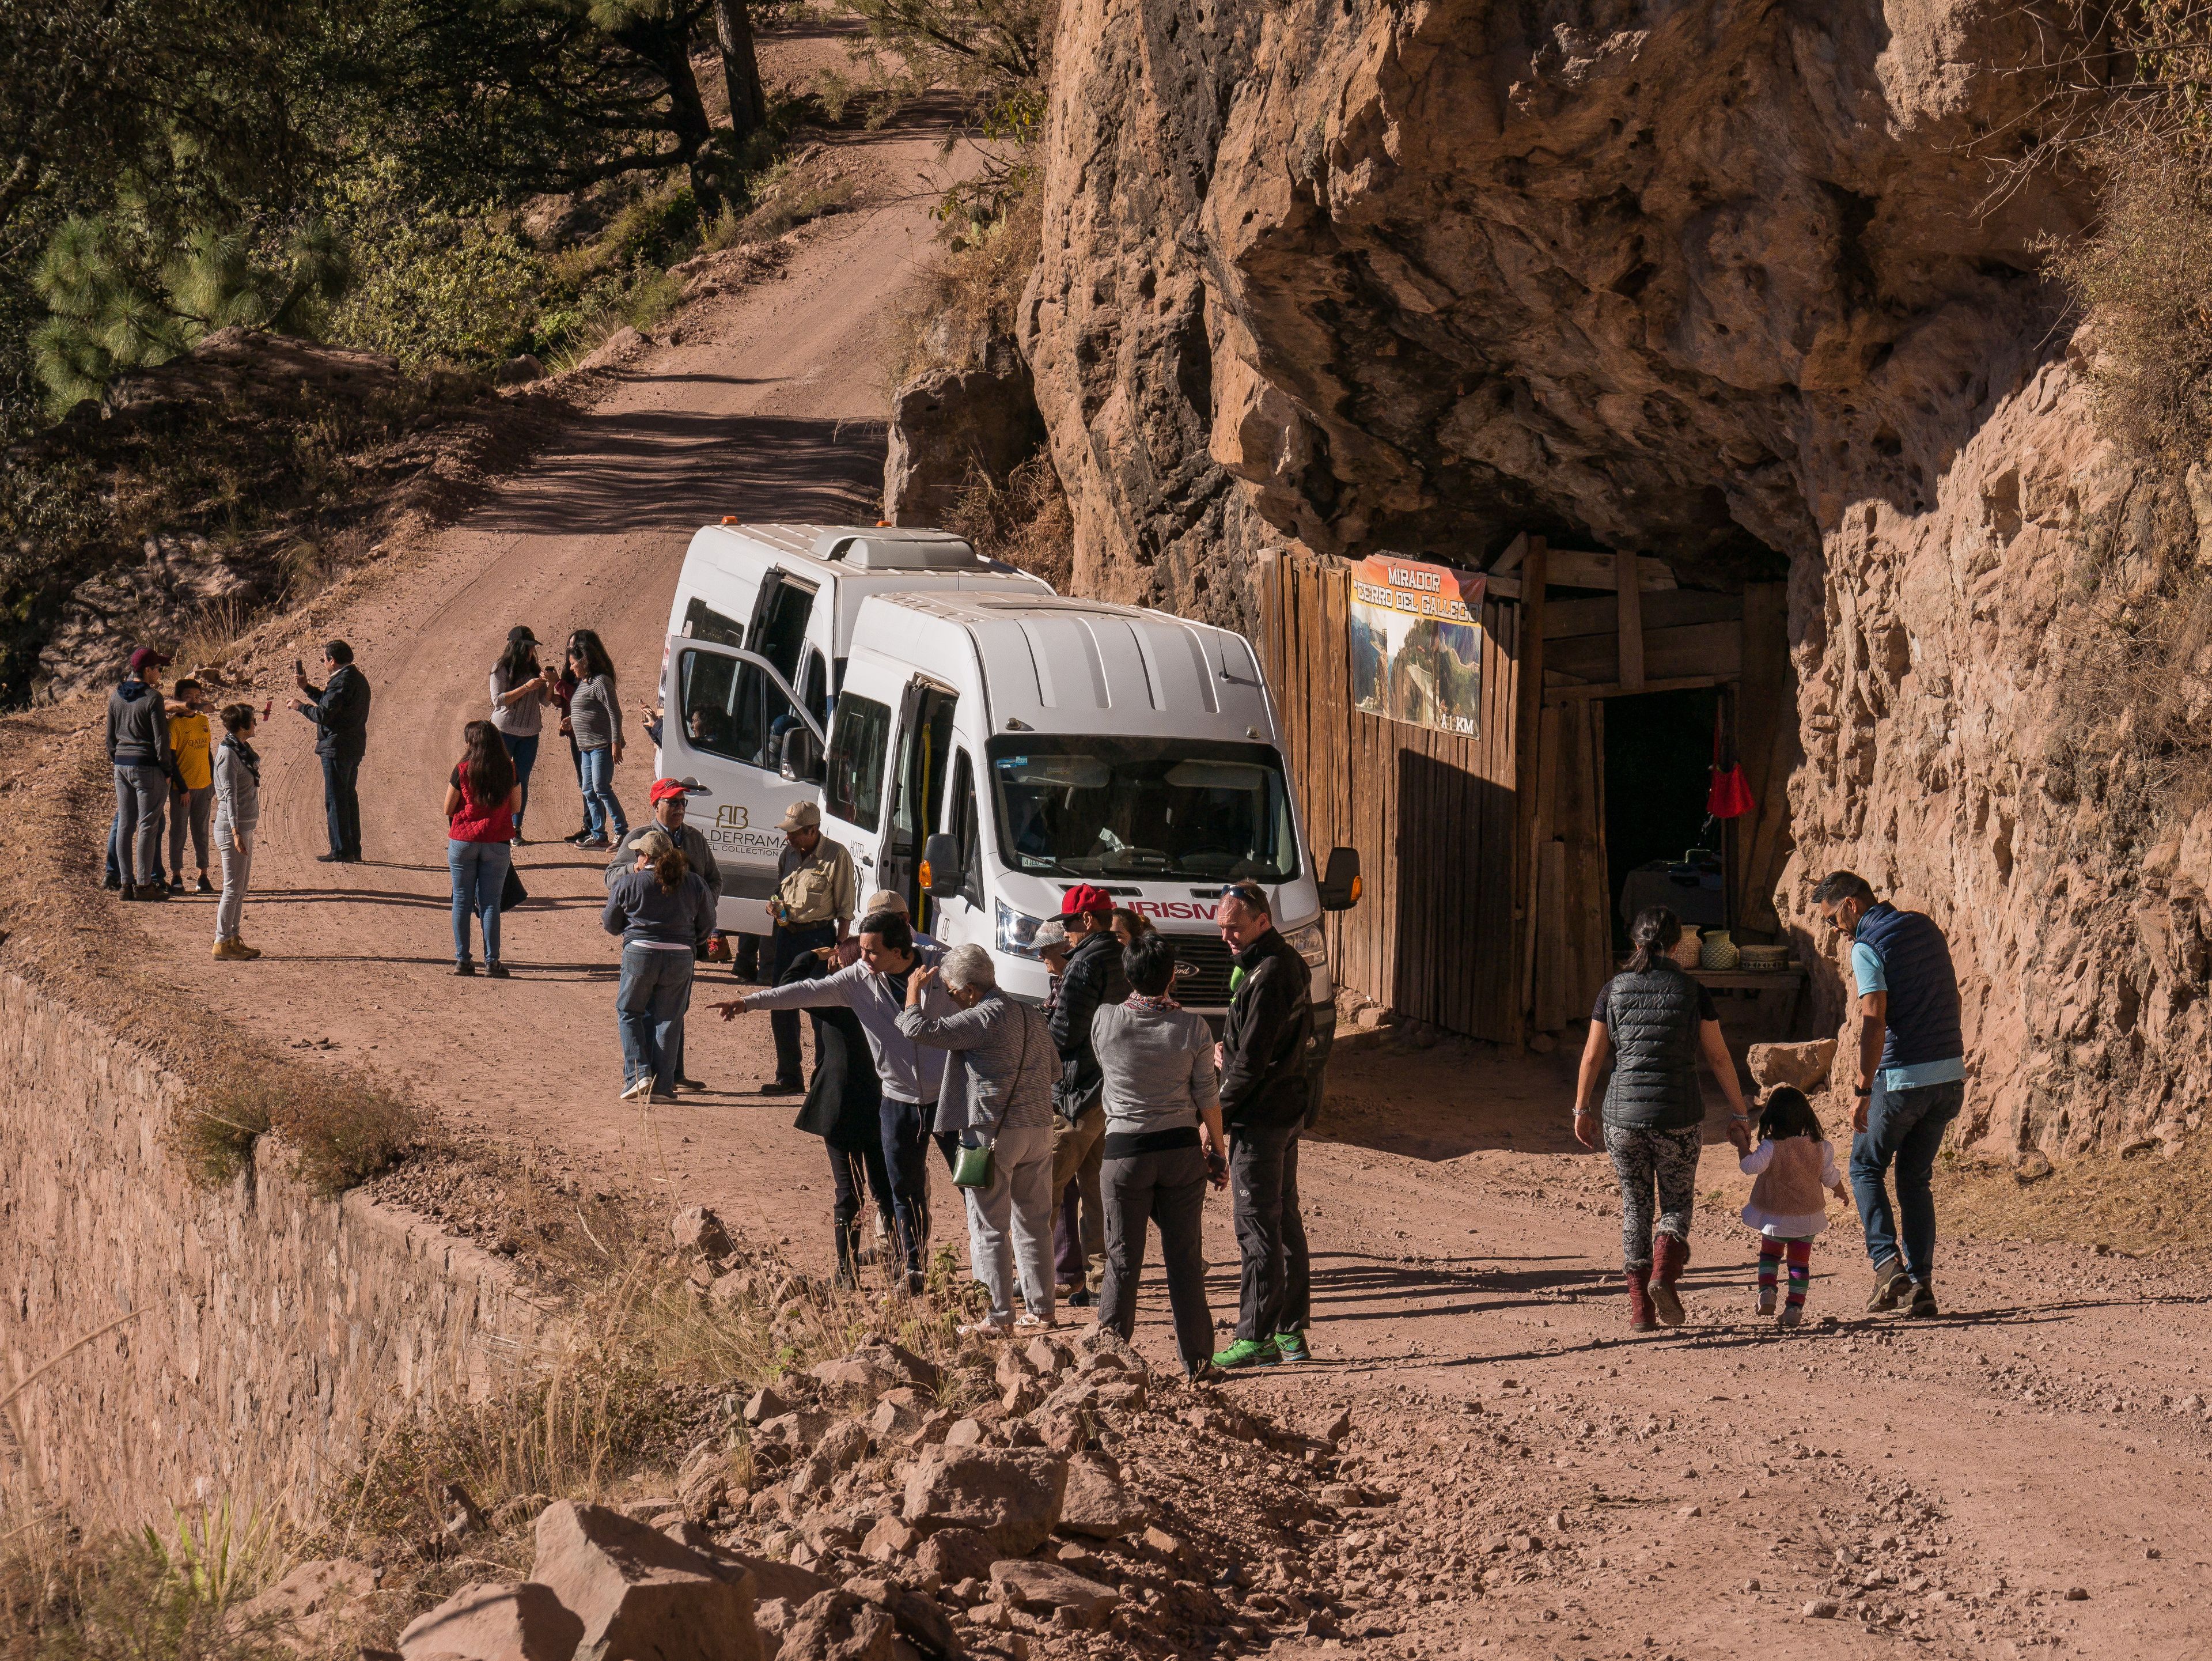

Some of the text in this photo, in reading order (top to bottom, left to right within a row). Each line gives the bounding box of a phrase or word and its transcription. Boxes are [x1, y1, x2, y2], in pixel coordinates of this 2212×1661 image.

[1388, 566, 1441, 593] MIRADOR
[1395, 591, 1418, 613] DEL
[1441, 713, 1448, 729] A
[1456, 716, 1474, 735] KM
[702, 829, 789, 849] LDERRAMA
[722, 845, 778, 856] COLLECTION
